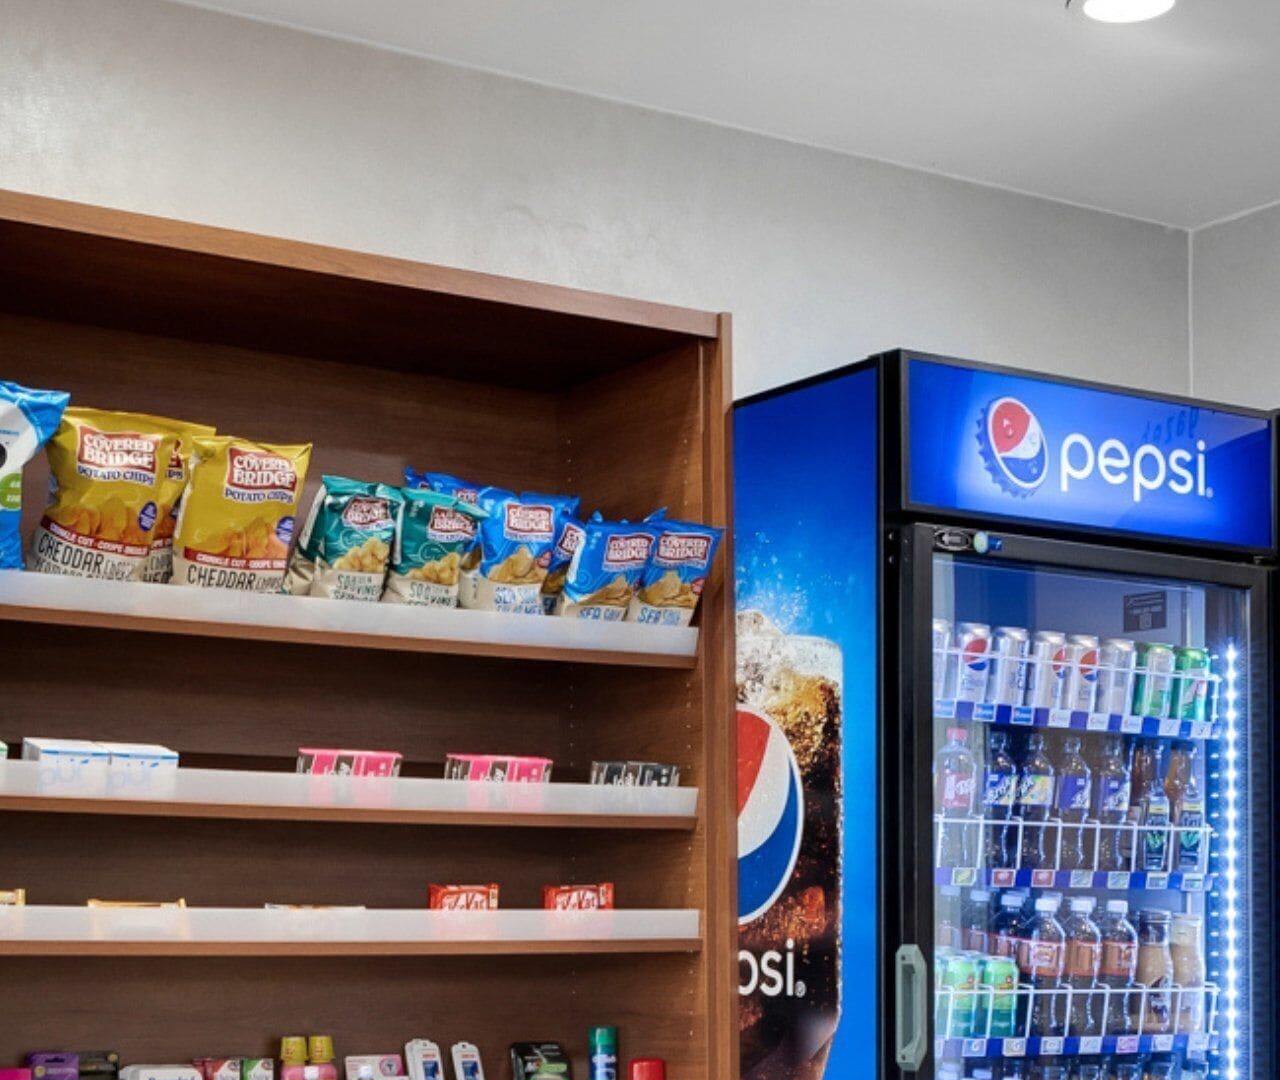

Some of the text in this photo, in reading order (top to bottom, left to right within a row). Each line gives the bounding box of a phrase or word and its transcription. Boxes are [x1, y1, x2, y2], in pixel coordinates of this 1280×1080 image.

[84, 434, 156, 453] COVERED
[83, 448, 154, 467] BRIDGE
[233, 455, 294, 471] COVERED
[1060, 432, 1207, 502] pepsi
[233, 468, 296, 487] BRIDGE
[38, 534, 104, 574] CHEDDAR
[187, 565, 256, 591] CHEDDAR
